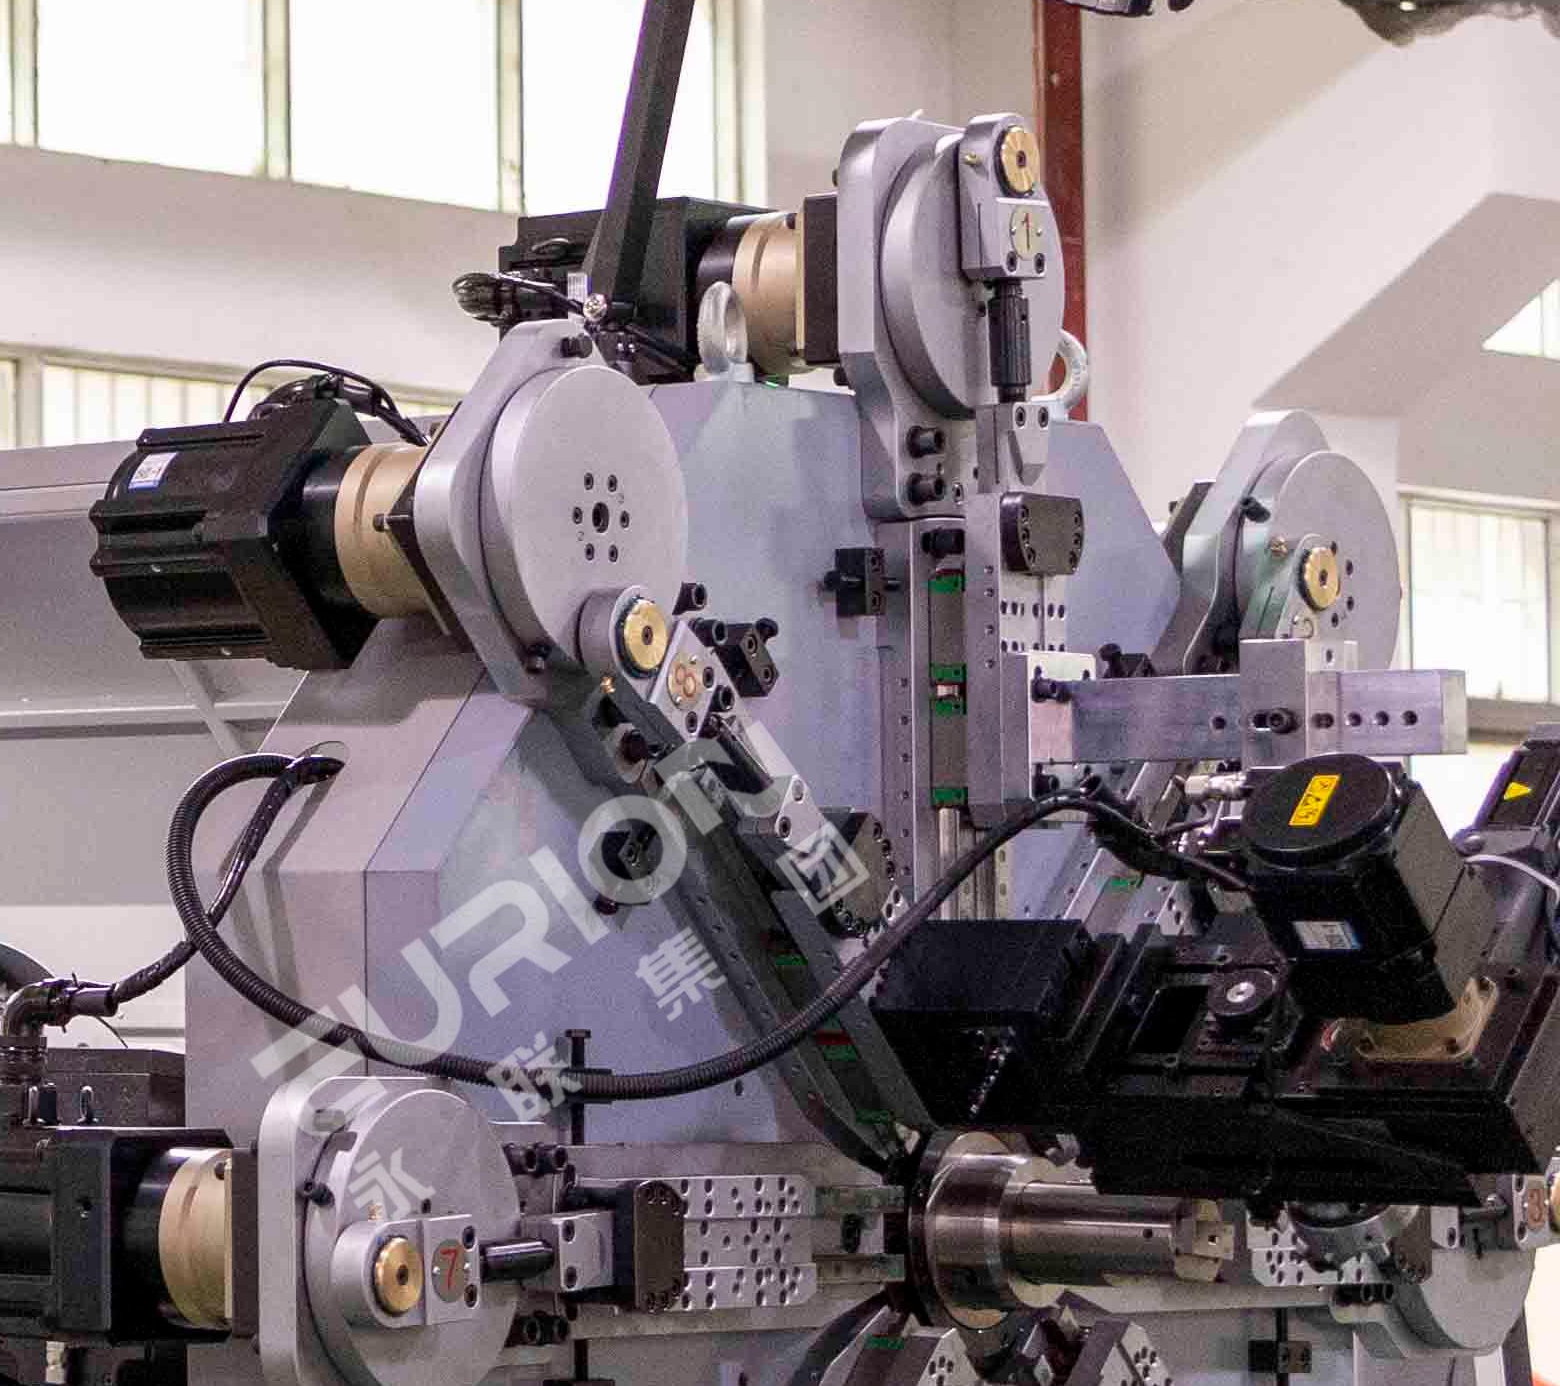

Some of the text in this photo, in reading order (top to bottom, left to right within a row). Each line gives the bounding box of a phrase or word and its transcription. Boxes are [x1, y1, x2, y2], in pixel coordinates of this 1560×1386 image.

[1022, 213, 1031, 250] 1
[675, 665, 696, 698] 8
[440, 1248, 458, 1290] 7
